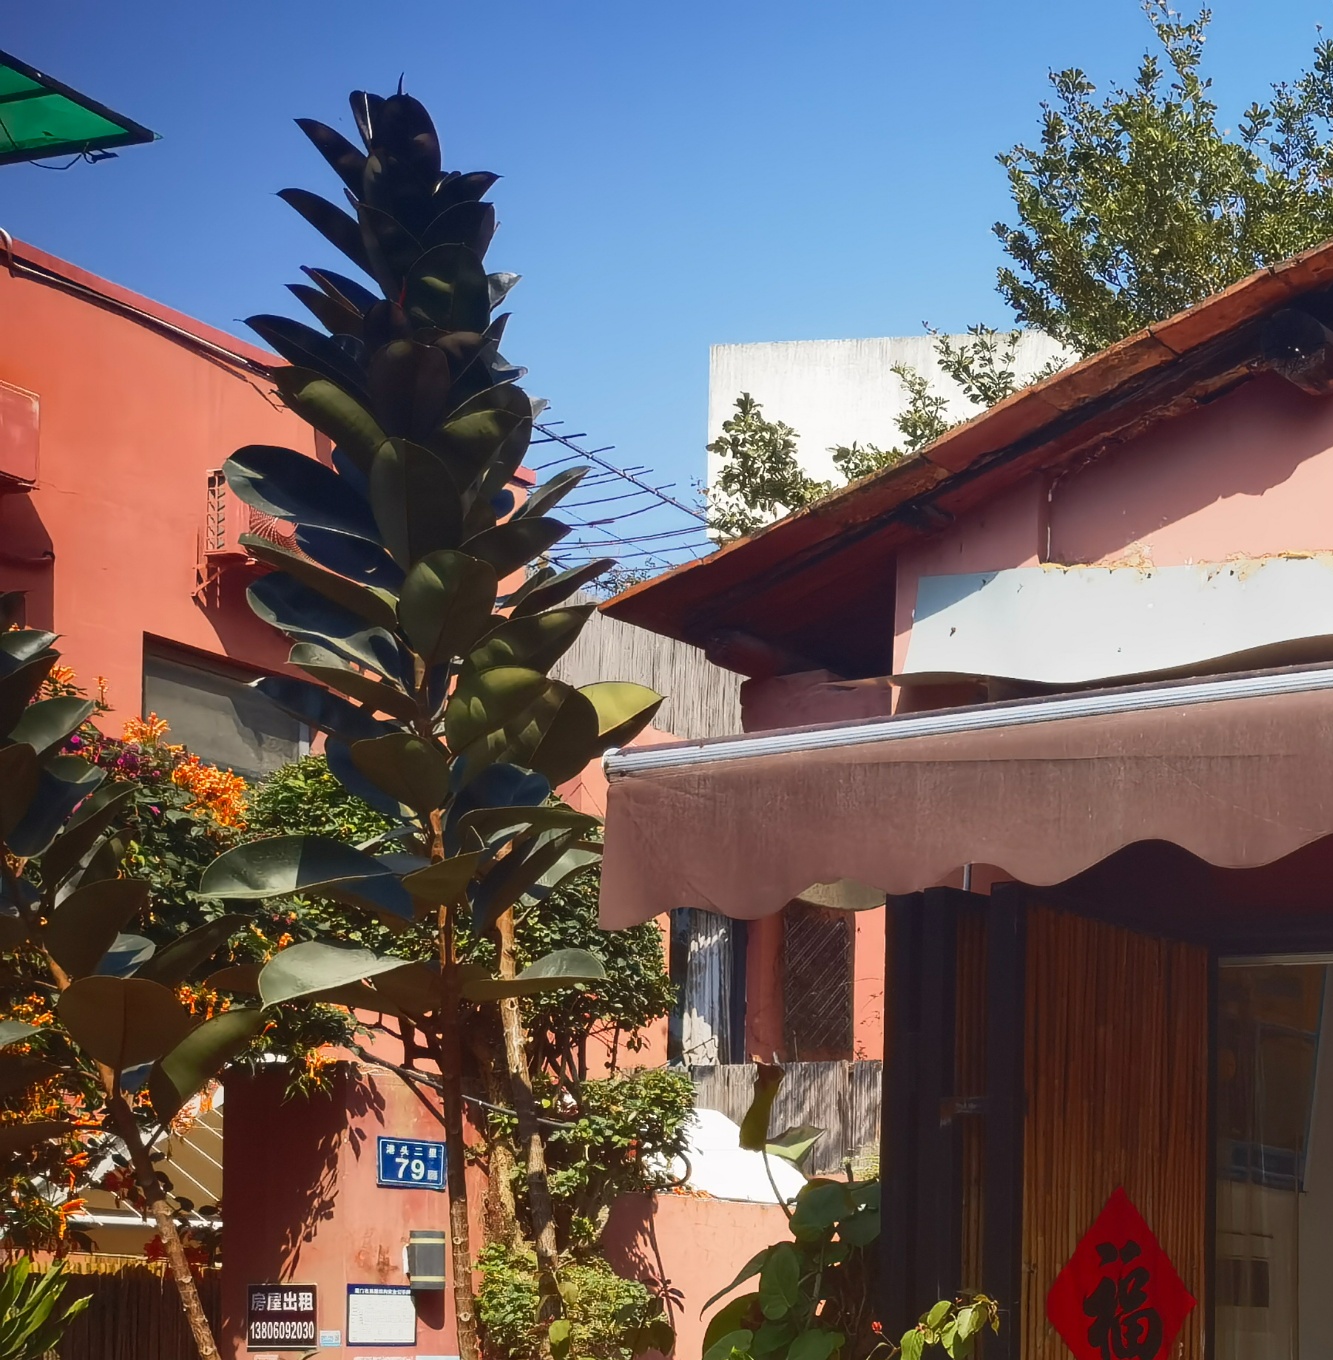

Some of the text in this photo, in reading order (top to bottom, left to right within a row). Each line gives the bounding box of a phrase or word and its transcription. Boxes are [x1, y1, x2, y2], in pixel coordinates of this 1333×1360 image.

[395, 1157, 425, 1180] 79
[251, 1291, 313, 1311] 房屋出租
[250, 1321, 315, 1340] 13806092030
